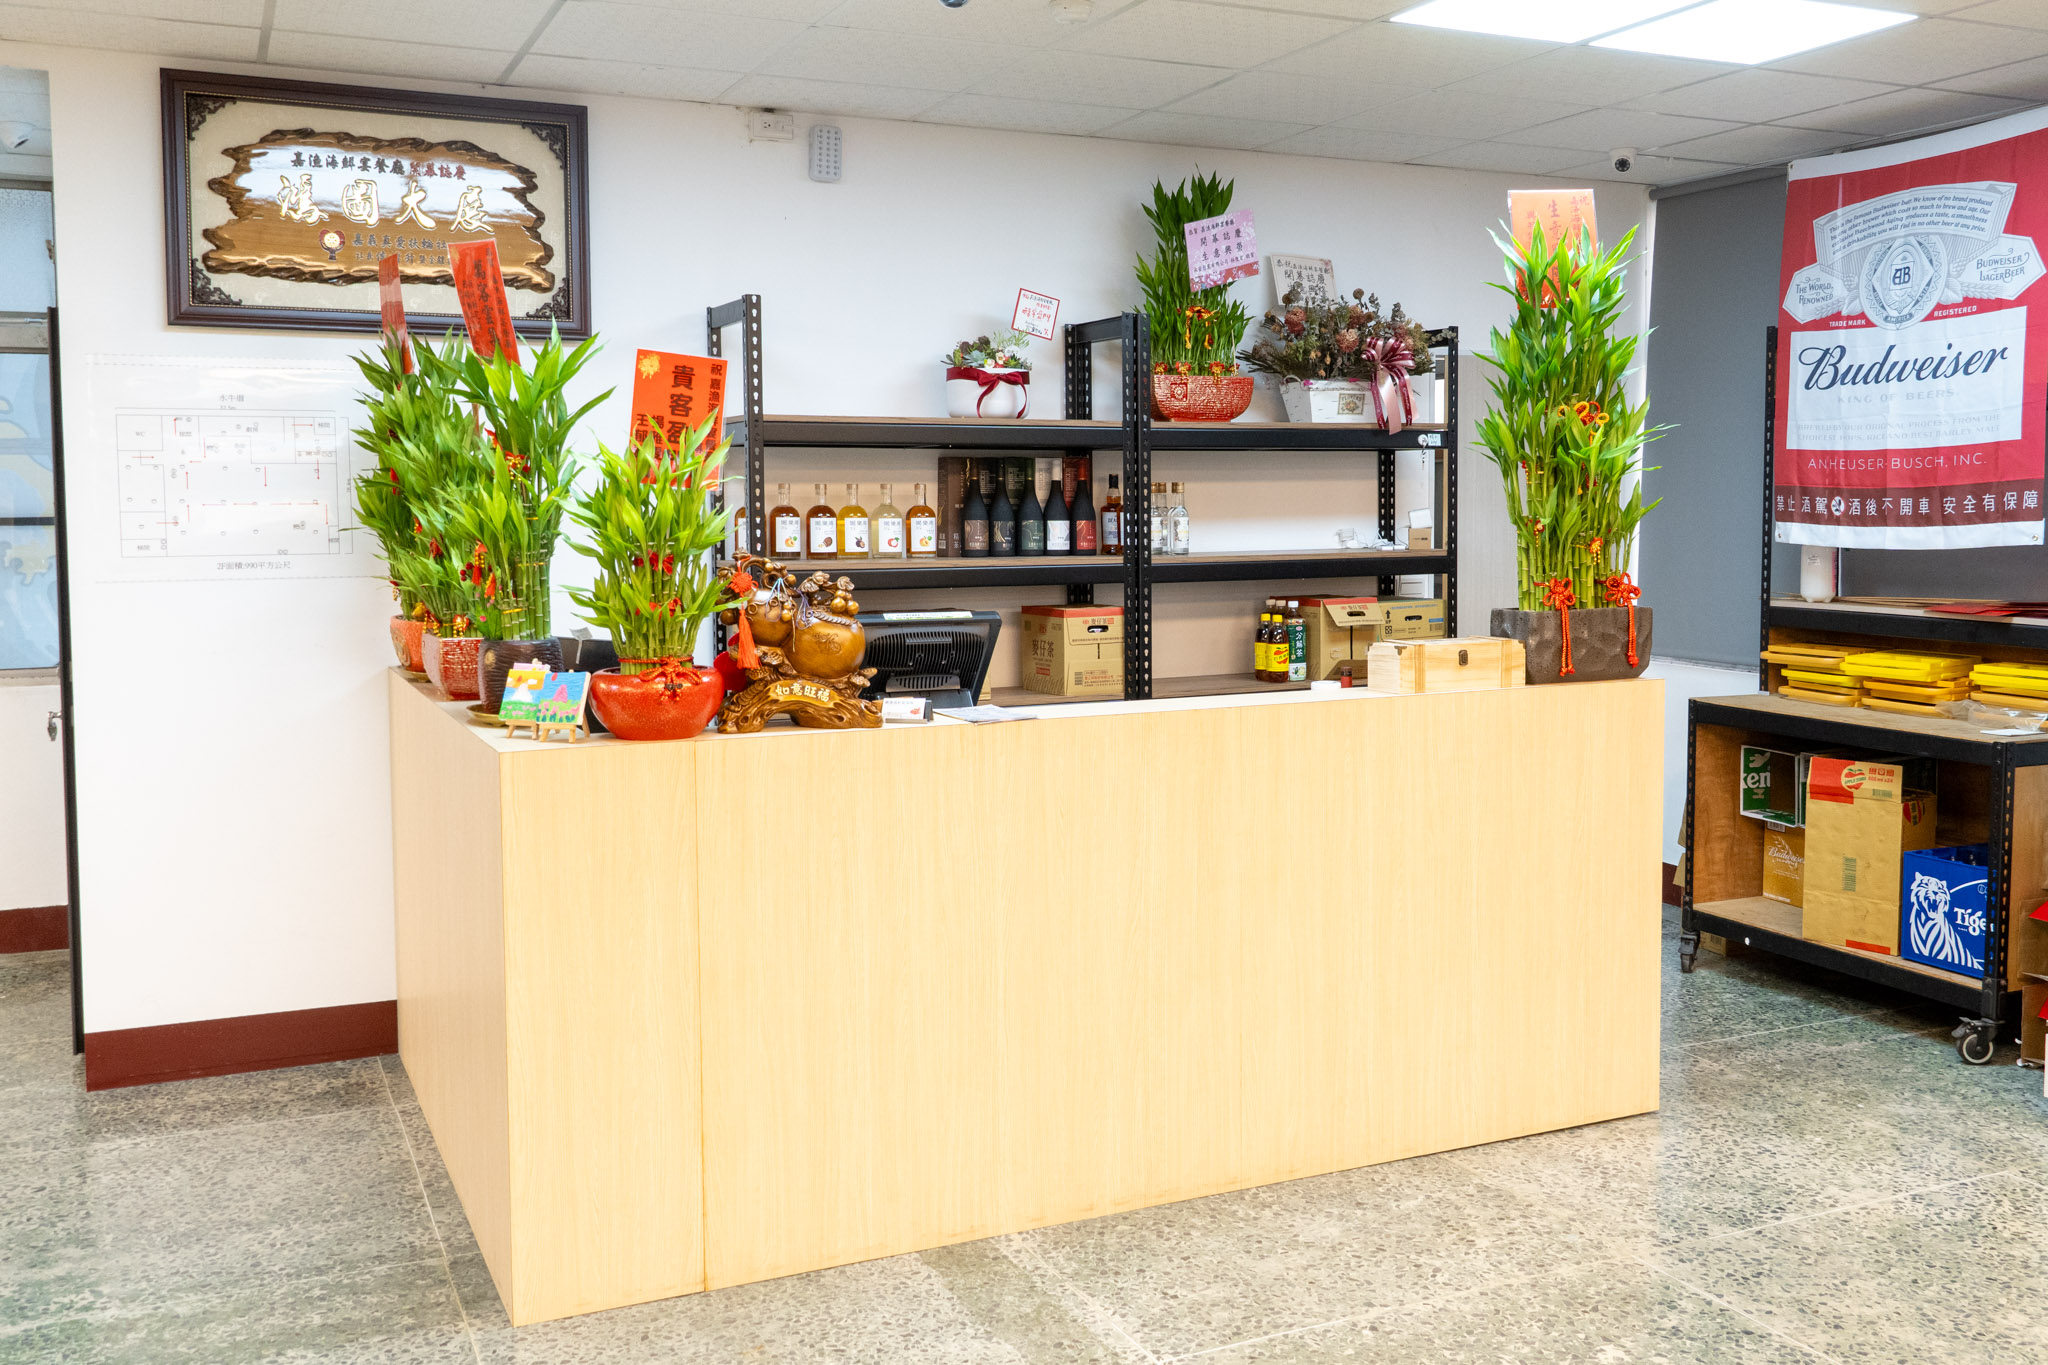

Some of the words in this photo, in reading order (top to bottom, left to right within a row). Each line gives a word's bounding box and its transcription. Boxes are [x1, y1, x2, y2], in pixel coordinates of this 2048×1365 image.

[290, 151, 406, 176] 嘉漁海鮮宴餐廳
[1967, 197, 1994, 207] produced
[1956, 213, 1988, 224] smoothness
[1934, 305, 1977, 317] REGISTERED
[710, 363, 723, 376] 祝
[1798, 342, 2009, 390] Budweiser
[1837, 394, 1873, 404] KING
[1953, 452, 1988, 466] INC.
[1776, 495, 1828, 515] 禁止酒駕
[1848, 496, 1931, 516] 酒後不開車
[1943, 490, 2039, 515] 安全有保障
[775, 682, 831, 703] 如意旺福
[1768, 845, 1805, 863] Budweise
[1953, 906, 1987, 937] Tige
